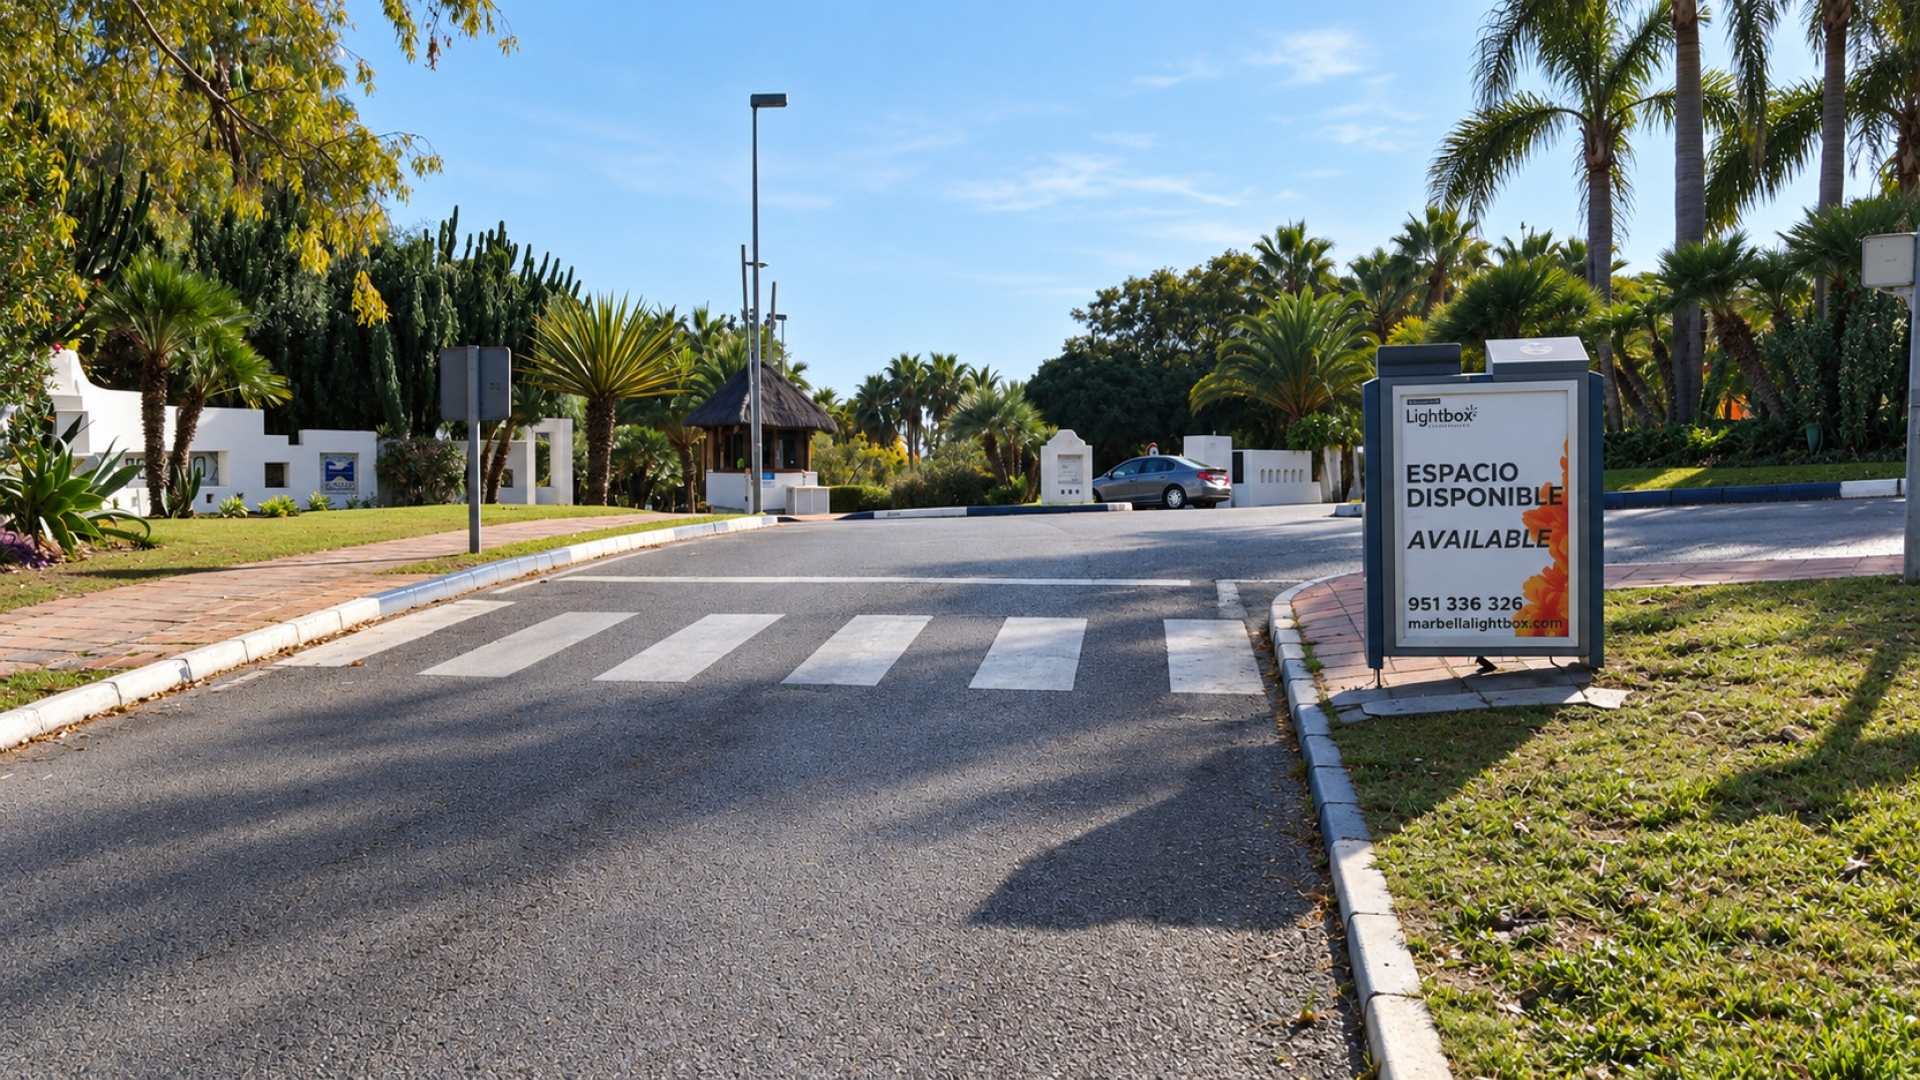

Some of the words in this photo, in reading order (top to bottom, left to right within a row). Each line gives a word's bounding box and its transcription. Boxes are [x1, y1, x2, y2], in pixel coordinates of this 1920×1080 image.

[1406, 408, 1474, 428] Lightbox
[1406, 462, 1519, 484] ESPACIO
[1406, 486, 1563, 508] DISPONIBLE
[1407, 529, 1553, 549] AVAILABLE
[1408, 596, 1440, 612] 951
[1446, 596, 1482, 612] 336
[1487, 596, 1523, 612] 326
[1408, 616, 1563, 632] marbellalightbox.com
